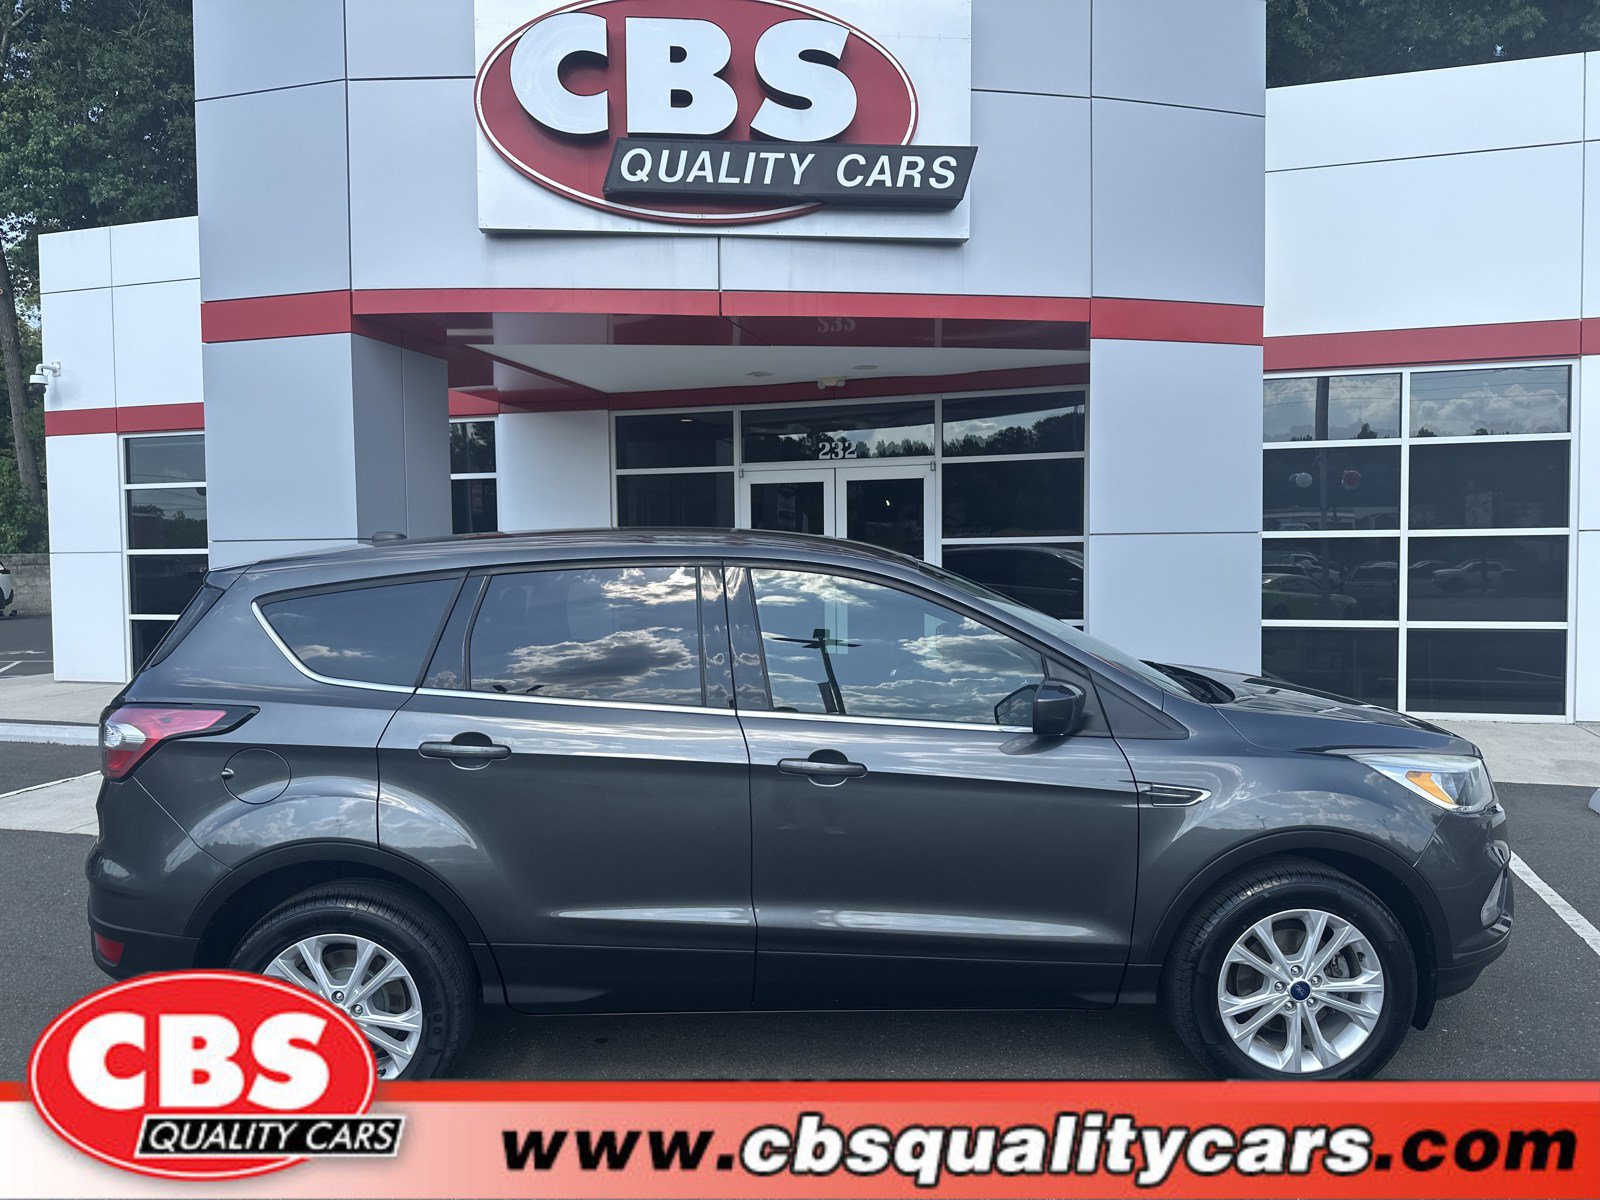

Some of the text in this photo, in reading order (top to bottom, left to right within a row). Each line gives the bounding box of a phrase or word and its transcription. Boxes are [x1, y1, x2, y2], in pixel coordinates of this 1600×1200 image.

[509, 12, 858, 142] CBS
[619, 147, 958, 190] QUALITY CARS
[818, 441, 858, 460] 232
